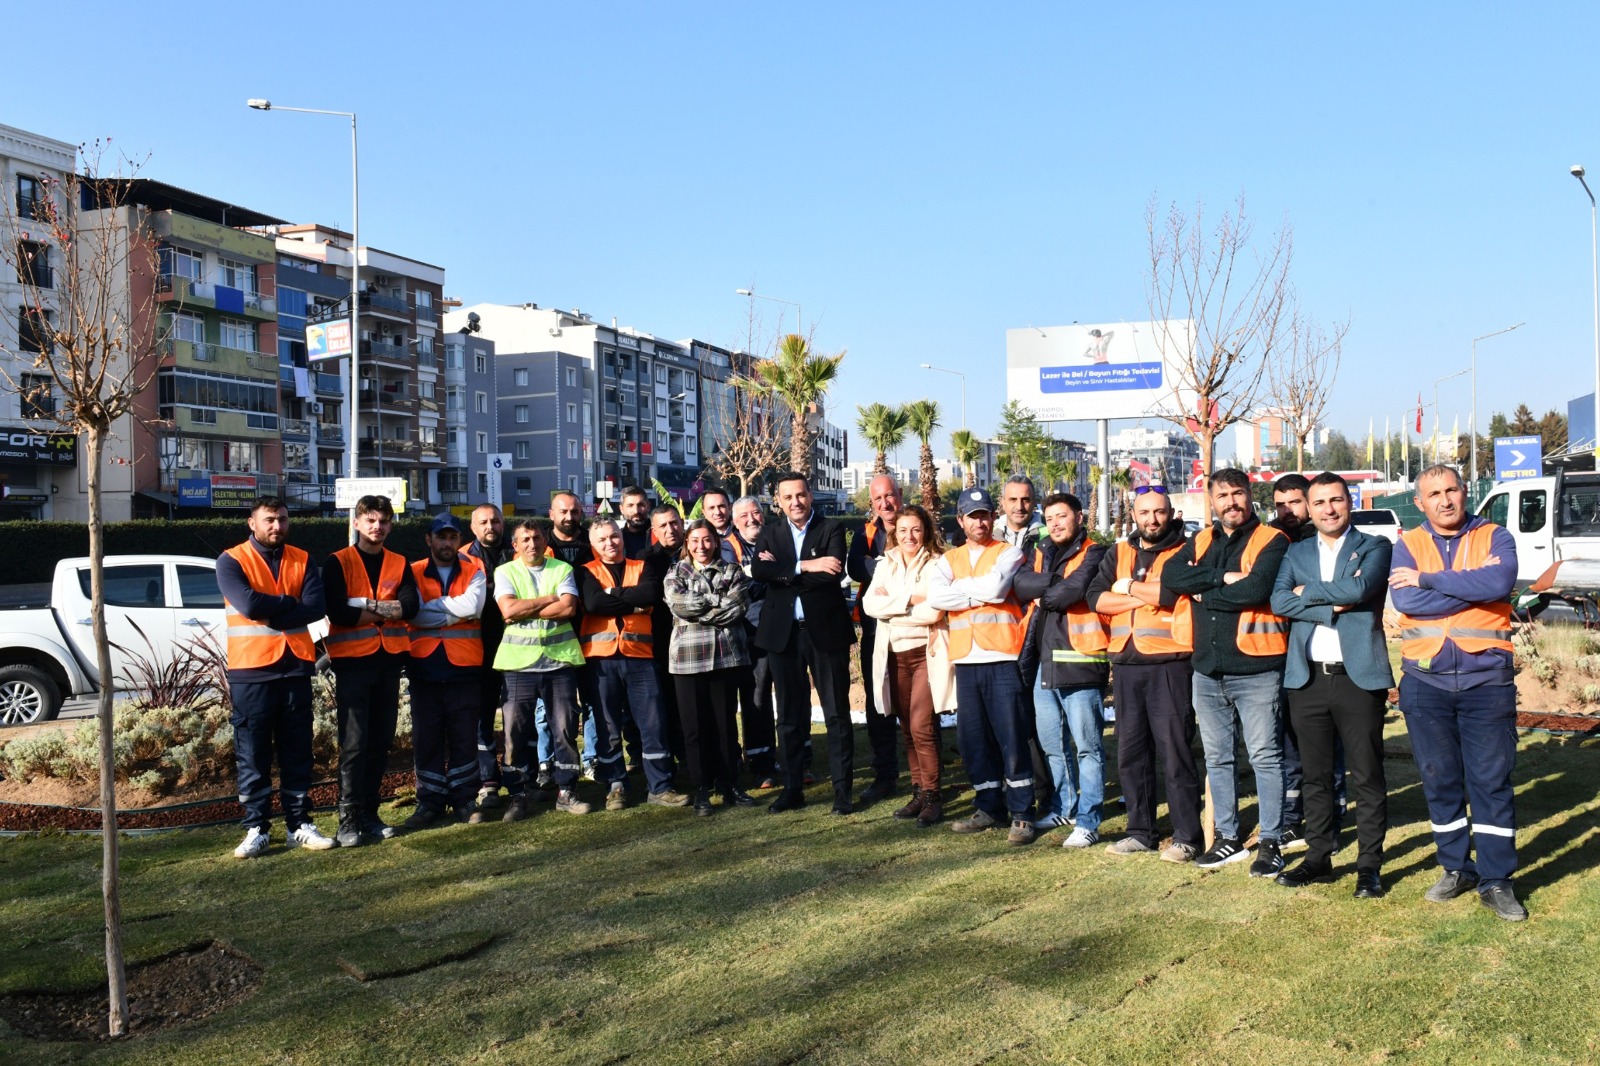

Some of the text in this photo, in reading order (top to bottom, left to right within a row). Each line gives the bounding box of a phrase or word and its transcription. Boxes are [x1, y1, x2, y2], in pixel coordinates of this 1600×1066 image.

[1089, 369, 1111, 379] Boyun
[1513, 437, 1539, 445] KABUL
[1501, 469, 1537, 478] METRO
